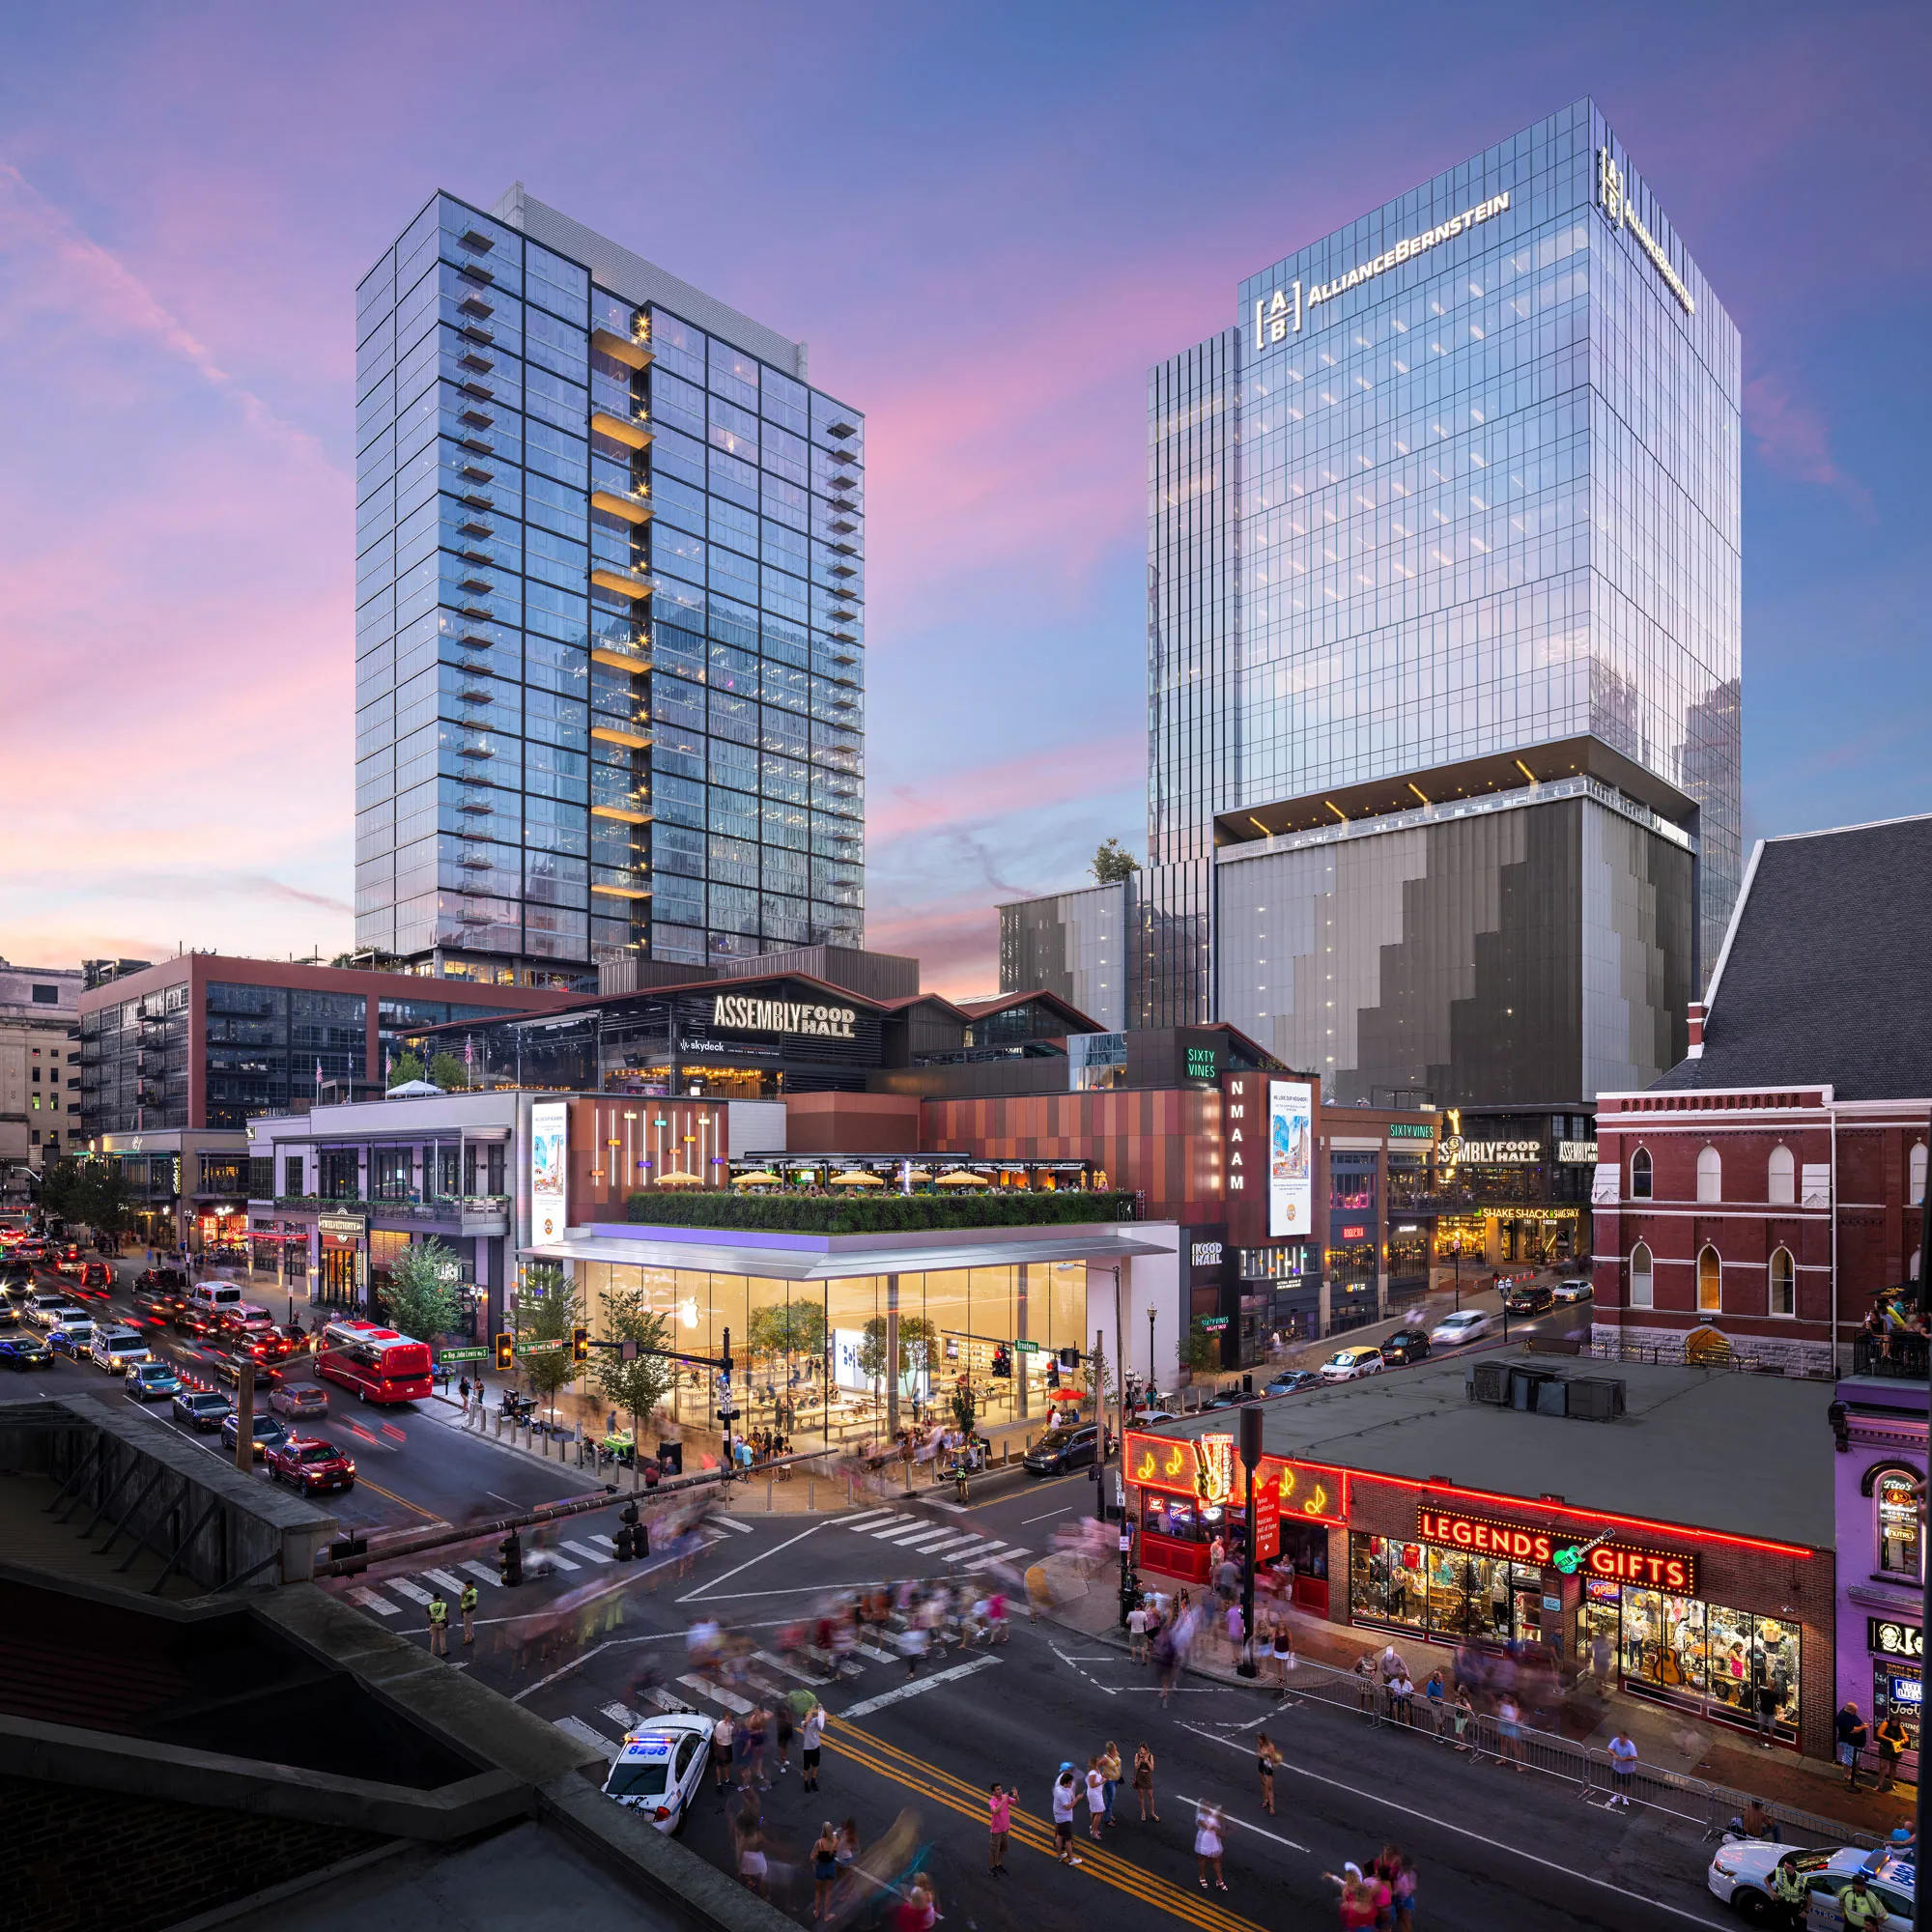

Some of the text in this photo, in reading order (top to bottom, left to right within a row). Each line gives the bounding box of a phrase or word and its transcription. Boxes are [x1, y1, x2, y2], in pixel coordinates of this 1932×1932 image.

[1270, 286, 1288, 313] A
[1270, 318, 1287, 343] B
[713, 995, 802, 1033] ASSEMBLY
[802, 1005, 856, 1023] FOOD
[802, 1019, 856, 1038] HALL
[690, 1039, 724, 1052] skydeck
[1187, 1048, 1215, 1063] SIXTY
[1188, 1064, 1215, 1078] VINES
[1390, 1124, 1434, 1138] SIXTY VINES
[1496, 1141, 1540, 1151] FOOD
[1559, 1141, 1588, 1162] ASSEMBLY
[1588, 1143, 1598, 1151] FOO
[1496, 1151, 1540, 1162] HALL
[1483, 1208, 1549, 1219] SHAKE SHACK
[1344, 1228, 1364, 1238] BOQUERIA
[1194, 1254, 1222, 1265] HALL
[1017, 1341, 1037, 1352] Broadway
[456, 1350, 466, 1359] John
[466, 1350, 477, 1358] Lewis
[1884, 1480, 1913, 1491] Tito's
[1257, 1504, 1275, 1513] Auditorium
[1257, 1517, 1273, 1525] Musicians
[1261, 1532, 1273, 1541] Museum
[1423, 1514, 1549, 1561] LEGENDS
[1592, 1548, 1684, 1586] GIFTS
[1594, 1584, 1619, 1595] OPEN
[1889, 1697, 1921, 1716] Toot
[1810, 1908, 1835, 1920] ETRO
